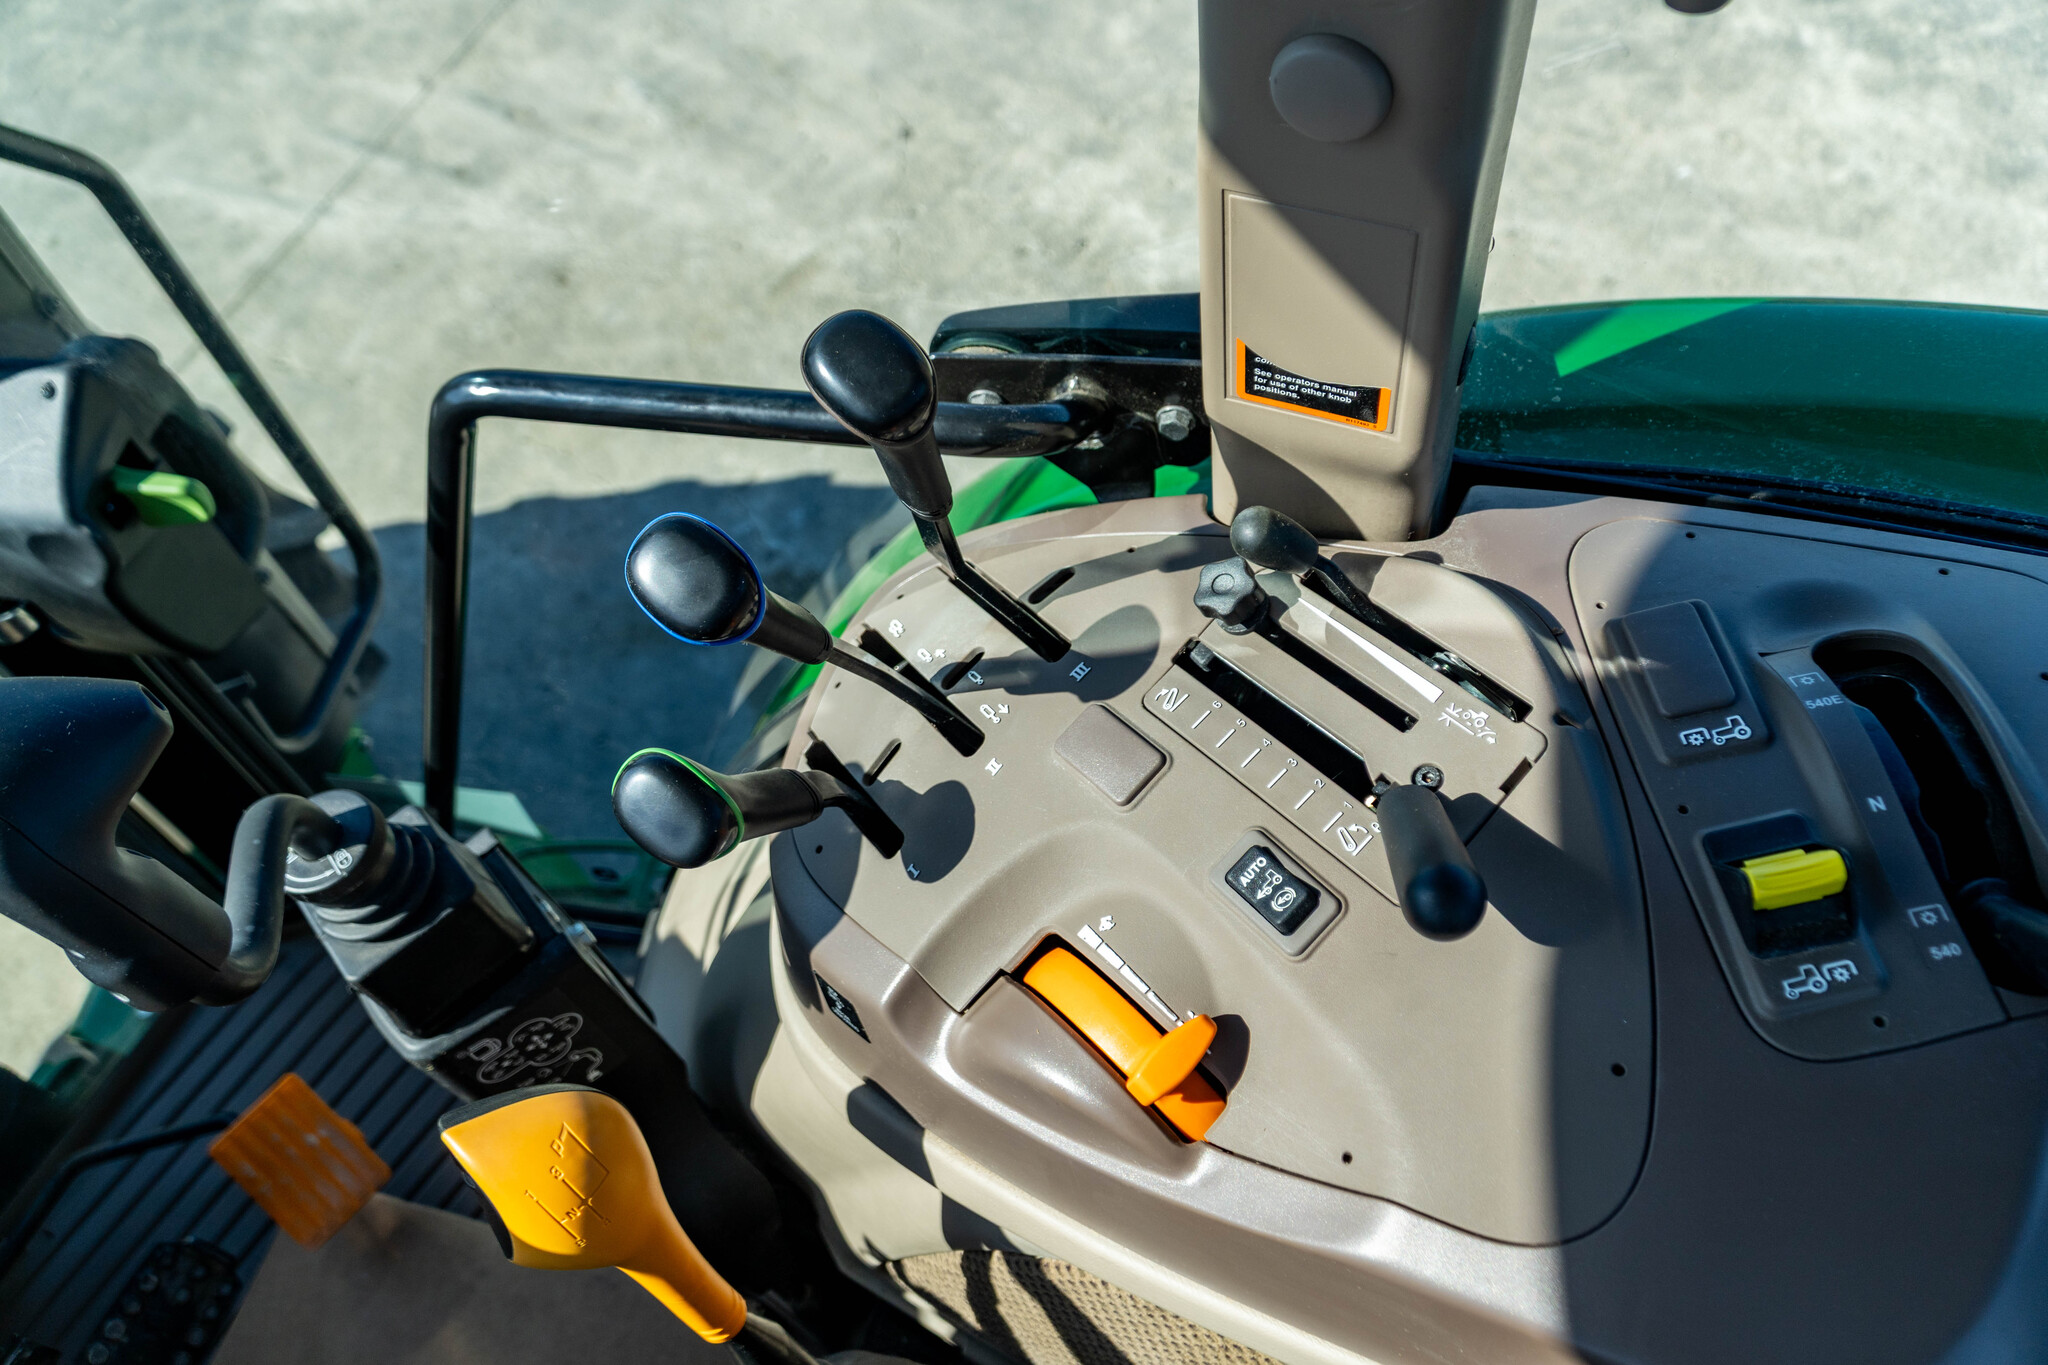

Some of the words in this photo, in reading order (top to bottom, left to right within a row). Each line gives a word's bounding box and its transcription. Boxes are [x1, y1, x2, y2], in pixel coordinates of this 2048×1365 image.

[1254, 367, 1272, 378] See
[1274, 374, 1320, 389] operators
[1322, 385, 1357, 397] manual
[1254, 375, 1268, 384] for
[1270, 380, 1287, 389] use
[1301, 387, 1326, 398] other
[1329, 393, 1352, 404] knob
[1254, 384, 1300, 400] positions.
[1212, 700, 1223, 710] 6
[1804, 694, 1844, 710] 540E
[1236, 718, 1248, 728] 5
[1262, 737, 1273, 748] 4
[1287, 758, 1299, 768] 3
[1313, 777, 1326, 790] 2
[1343, 801, 1354, 810] 1
[1867, 796, 1887, 812] N
[1240, 857, 1267, 887] AUTO
[1927, 943, 1962, 961] 540
[550, 1138, 565, 1159] P
[549, 1165, 565, 1181] 3
[566, 1207, 581, 1220] N
